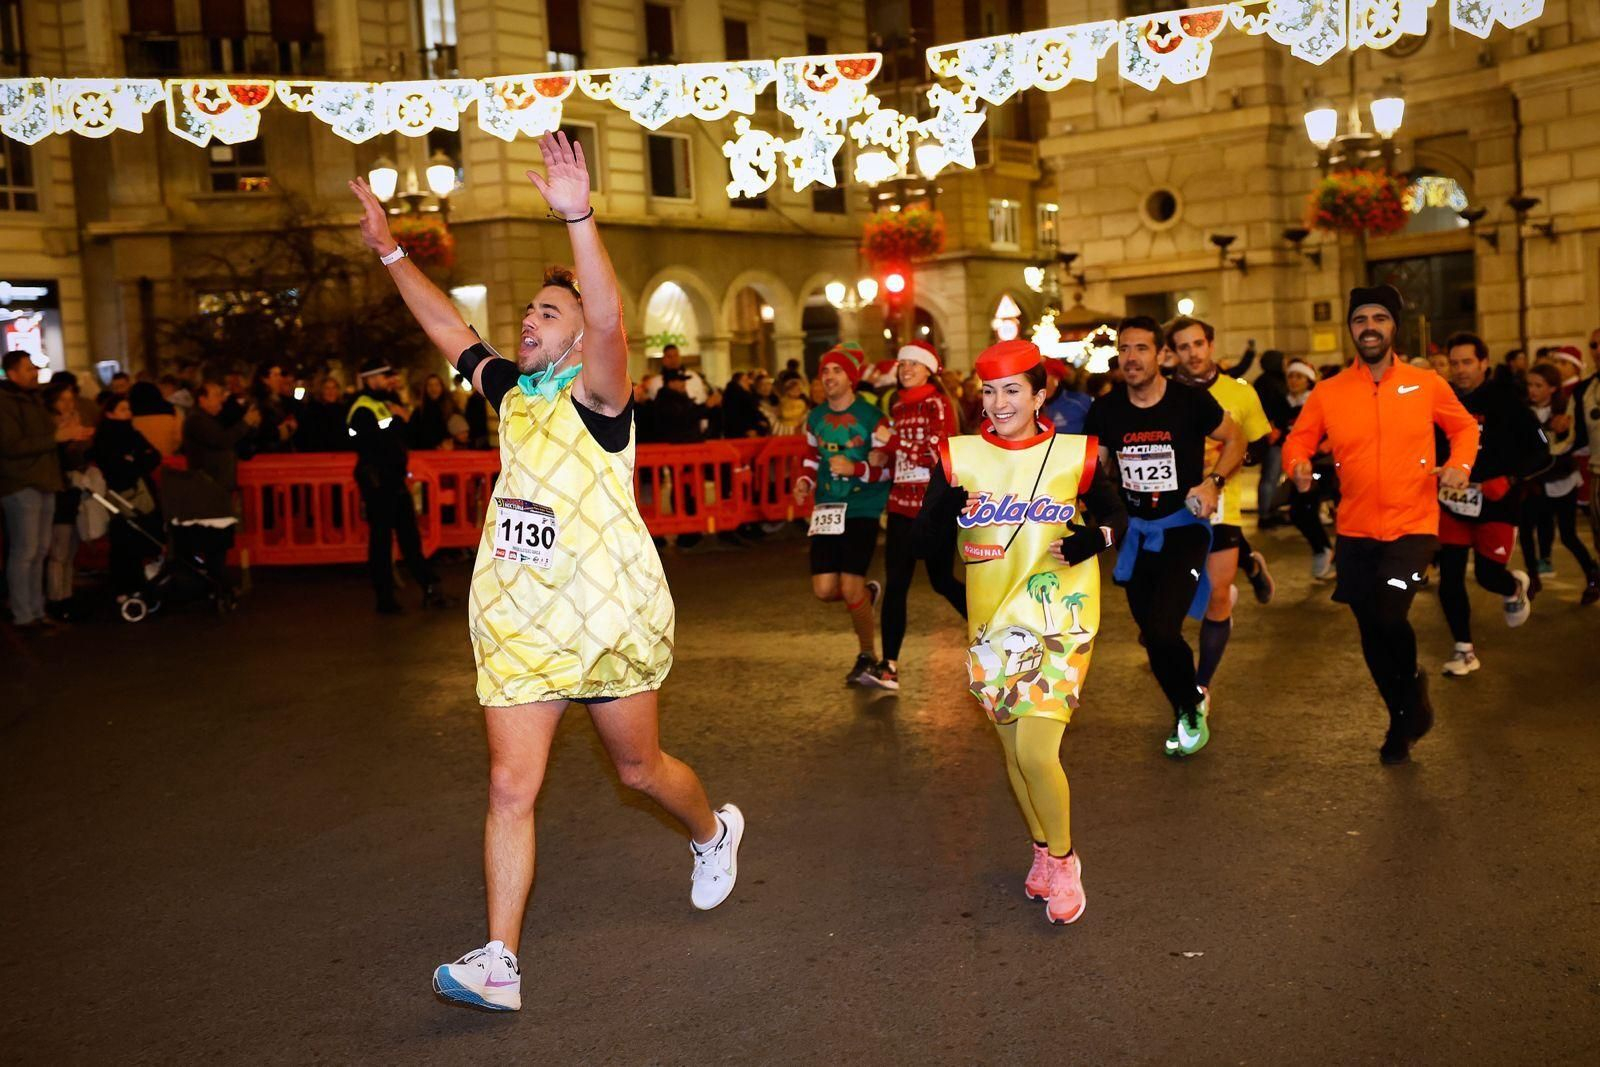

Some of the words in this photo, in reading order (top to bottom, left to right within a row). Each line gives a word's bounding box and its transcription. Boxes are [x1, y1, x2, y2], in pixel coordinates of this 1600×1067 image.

[1122, 431, 1172, 444] CARRERA
[1121, 444, 1173, 455] NOCTURNA
[1123, 465, 1172, 480] 1123
[1442, 490, 1479, 506] 1444
[814, 513, 842, 526] 1353
[501, 518, 556, 550] 1130
[964, 546, 1003, 557] ORIGINAL
